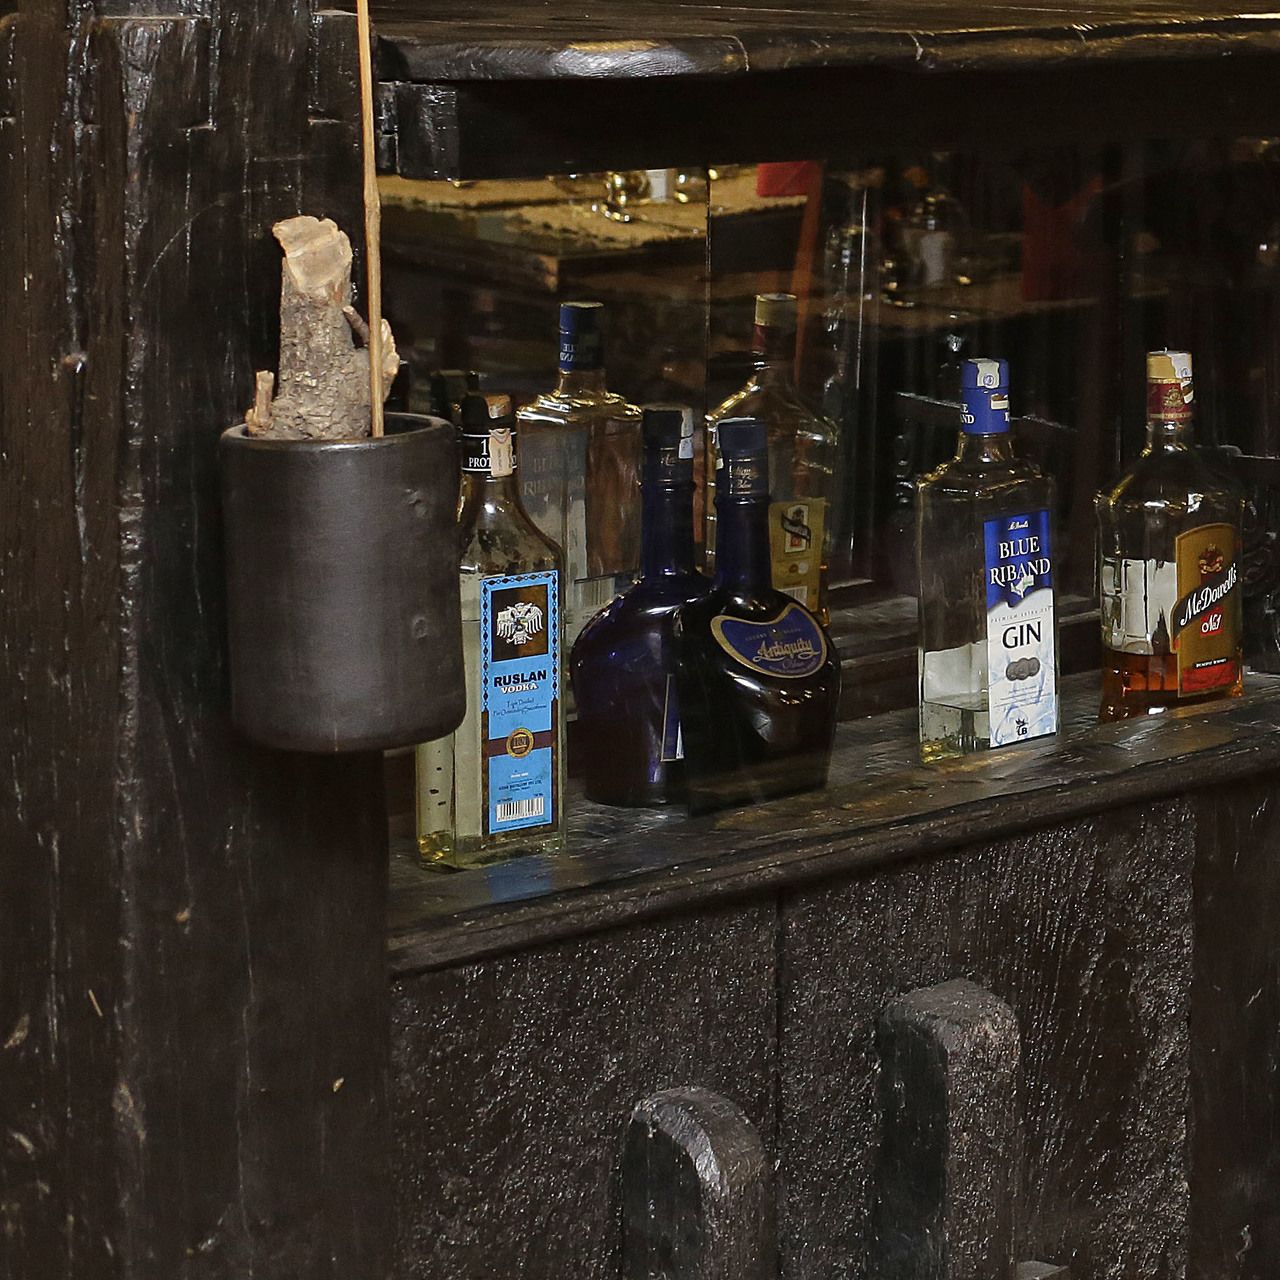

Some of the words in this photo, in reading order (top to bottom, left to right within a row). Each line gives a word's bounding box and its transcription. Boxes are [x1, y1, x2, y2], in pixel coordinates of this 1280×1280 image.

[999, 536, 1041, 559] BLUE
[990, 558, 1052, 587] RIBAND
[1180, 562, 1237, 626] McDowell's
[1002, 621, 1041, 649] GIN
[493, 669, 547, 688] RUSLAN
[501, 682, 538, 694] VODKA
